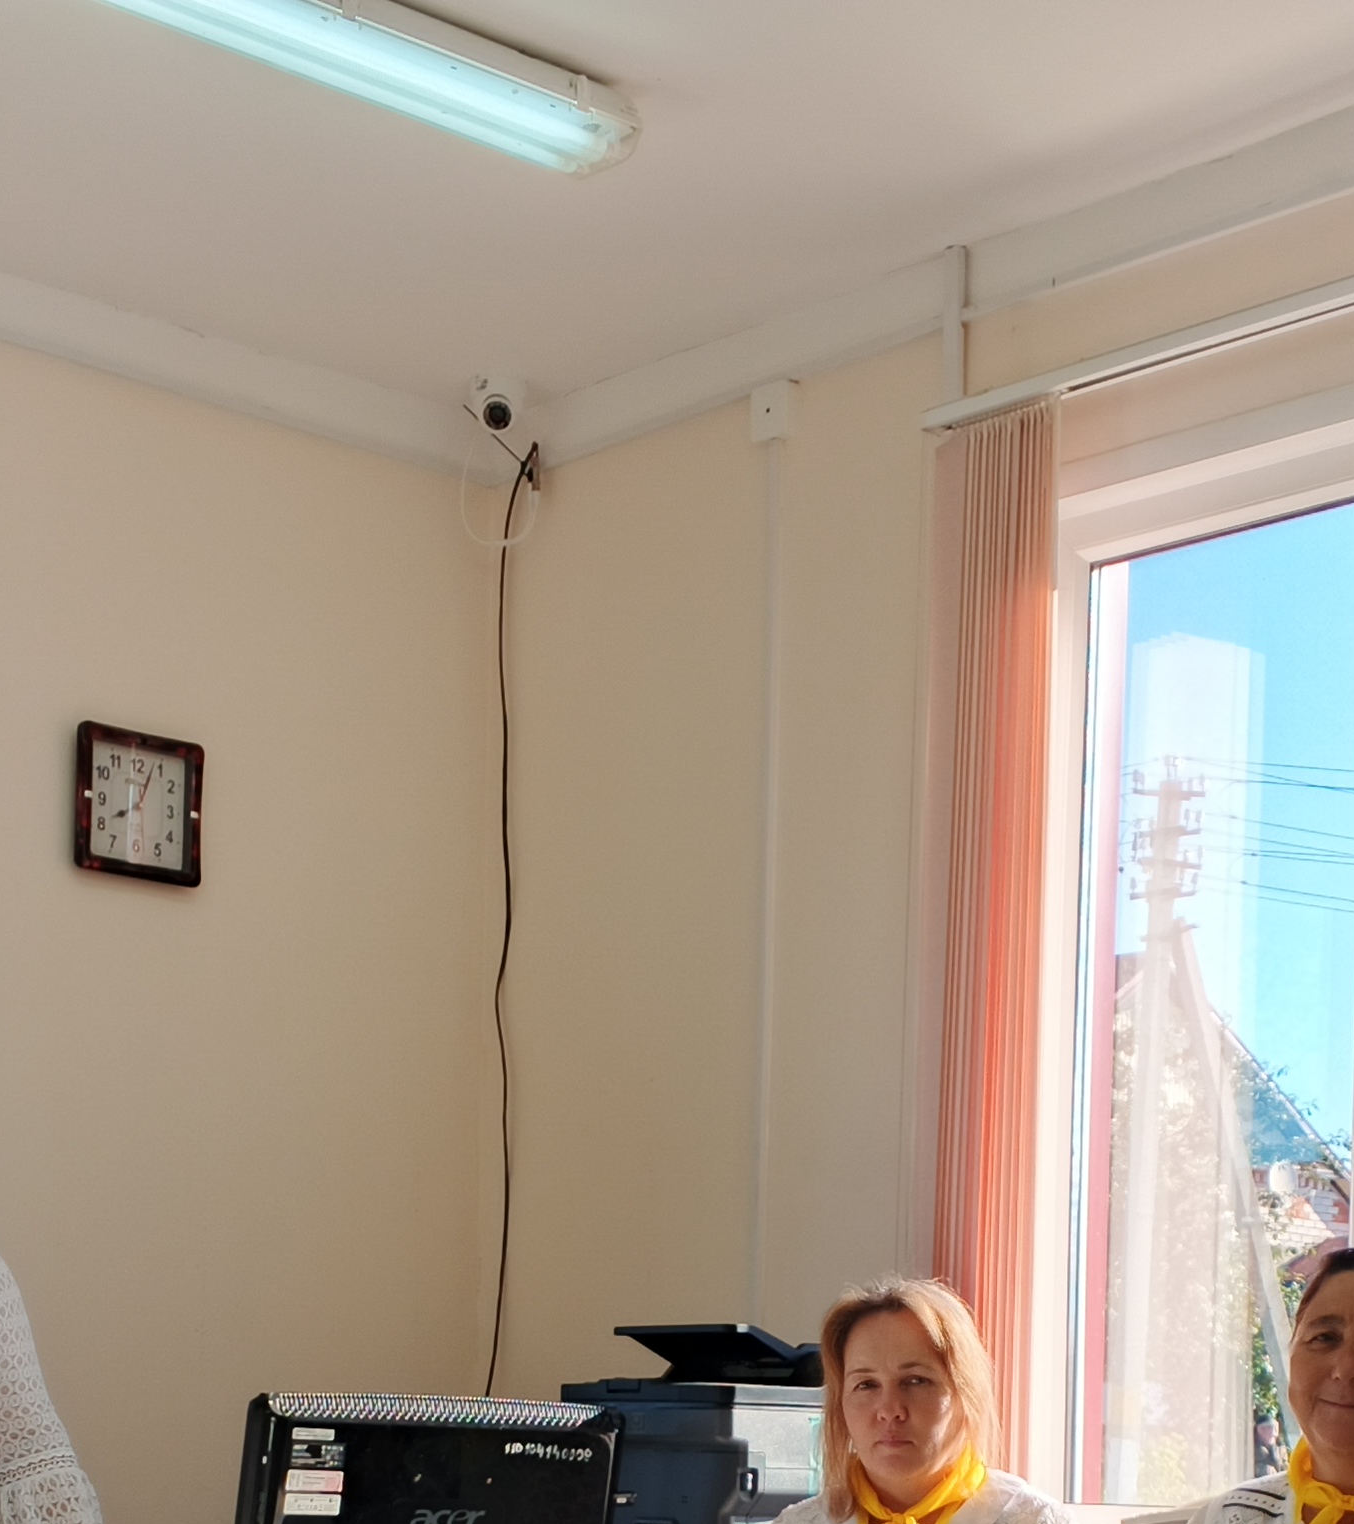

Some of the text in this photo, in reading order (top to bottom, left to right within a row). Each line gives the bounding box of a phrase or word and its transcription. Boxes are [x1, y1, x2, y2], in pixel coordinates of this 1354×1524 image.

[109, 753, 121, 769] 11
[131, 758, 145, 774] 12
[96, 765, 110, 781] 10
[157, 763, 163, 778] 1
[167, 779, 175, 794] 2
[97, 791, 106, 806] 9
[166, 805, 174, 819] 3
[97, 816, 106, 831] 8
[109, 834, 117, 849] 7
[165, 829, 173, 844] 4
[132, 839, 140, 853] 6
[153, 842, 162, 857] 5
